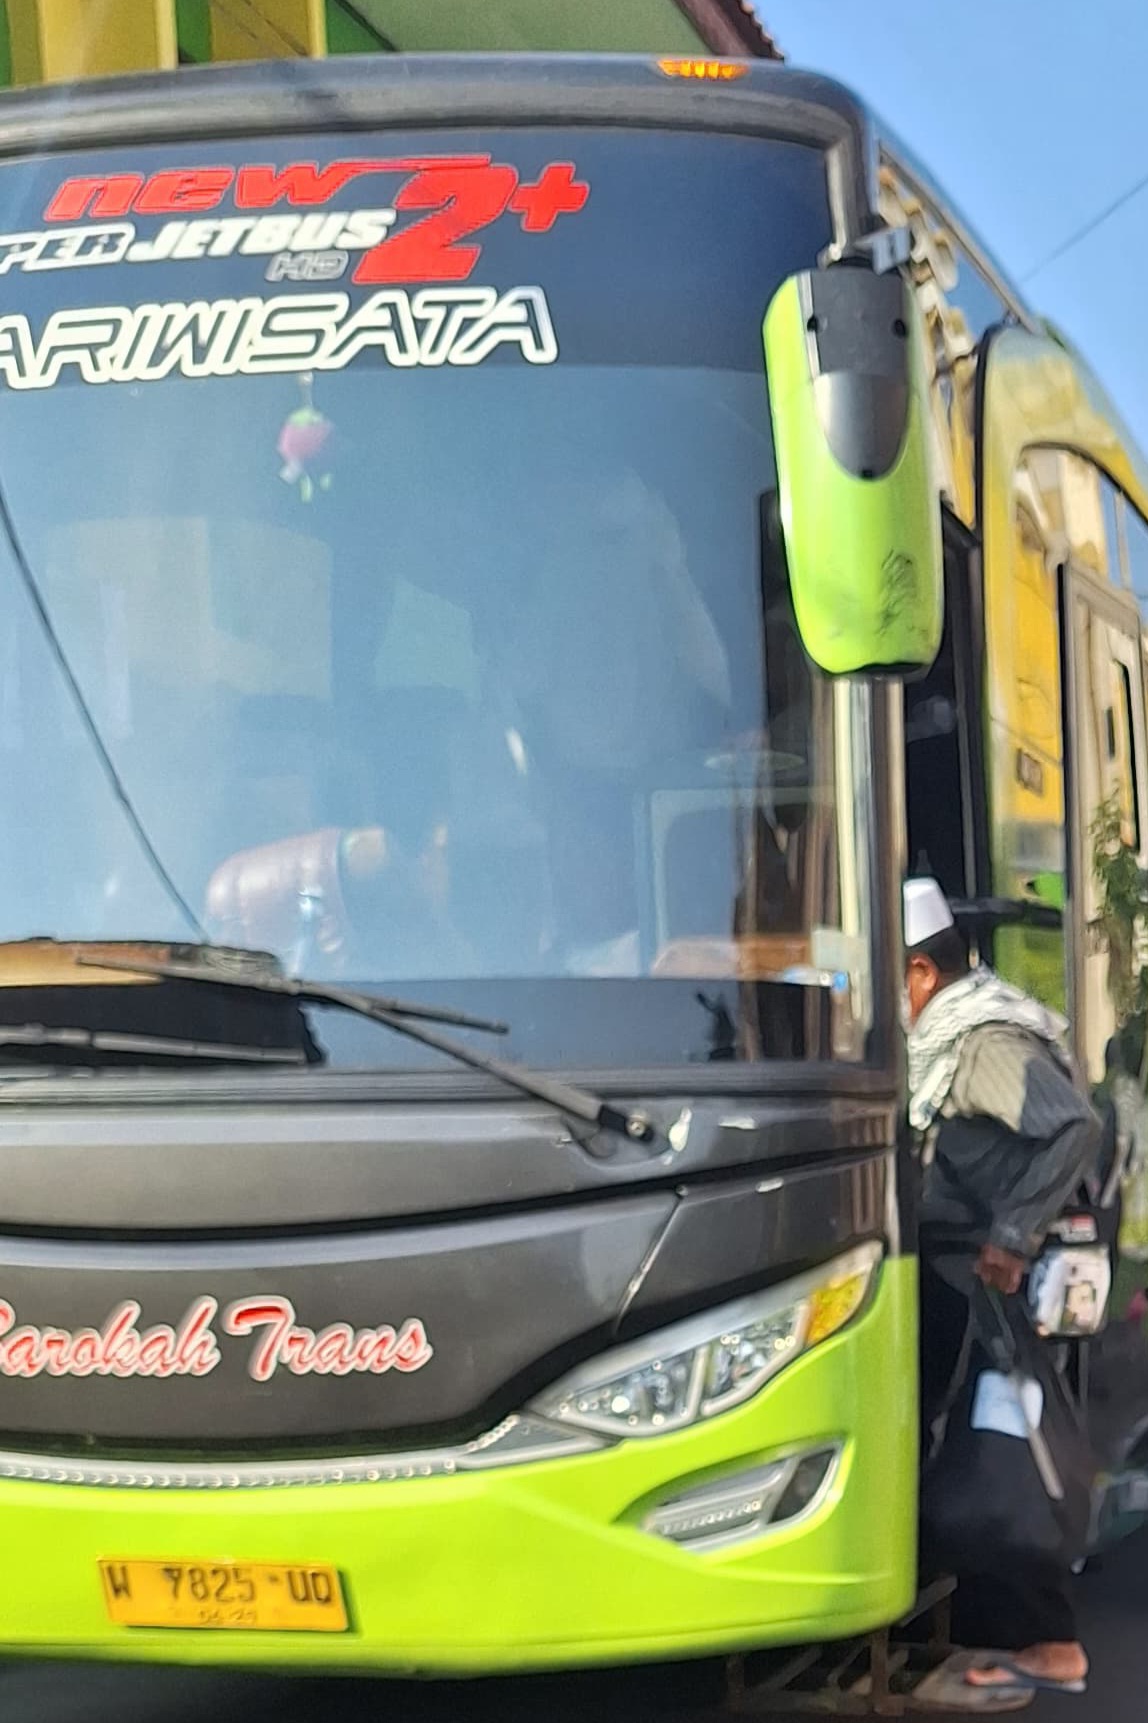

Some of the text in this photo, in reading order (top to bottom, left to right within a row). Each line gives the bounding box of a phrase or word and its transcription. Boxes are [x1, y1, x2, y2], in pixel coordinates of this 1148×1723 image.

[222, 1295, 433, 1382] Trans
[106, 1565, 131, 1600] W
[161, 1566, 256, 1603] 7825
